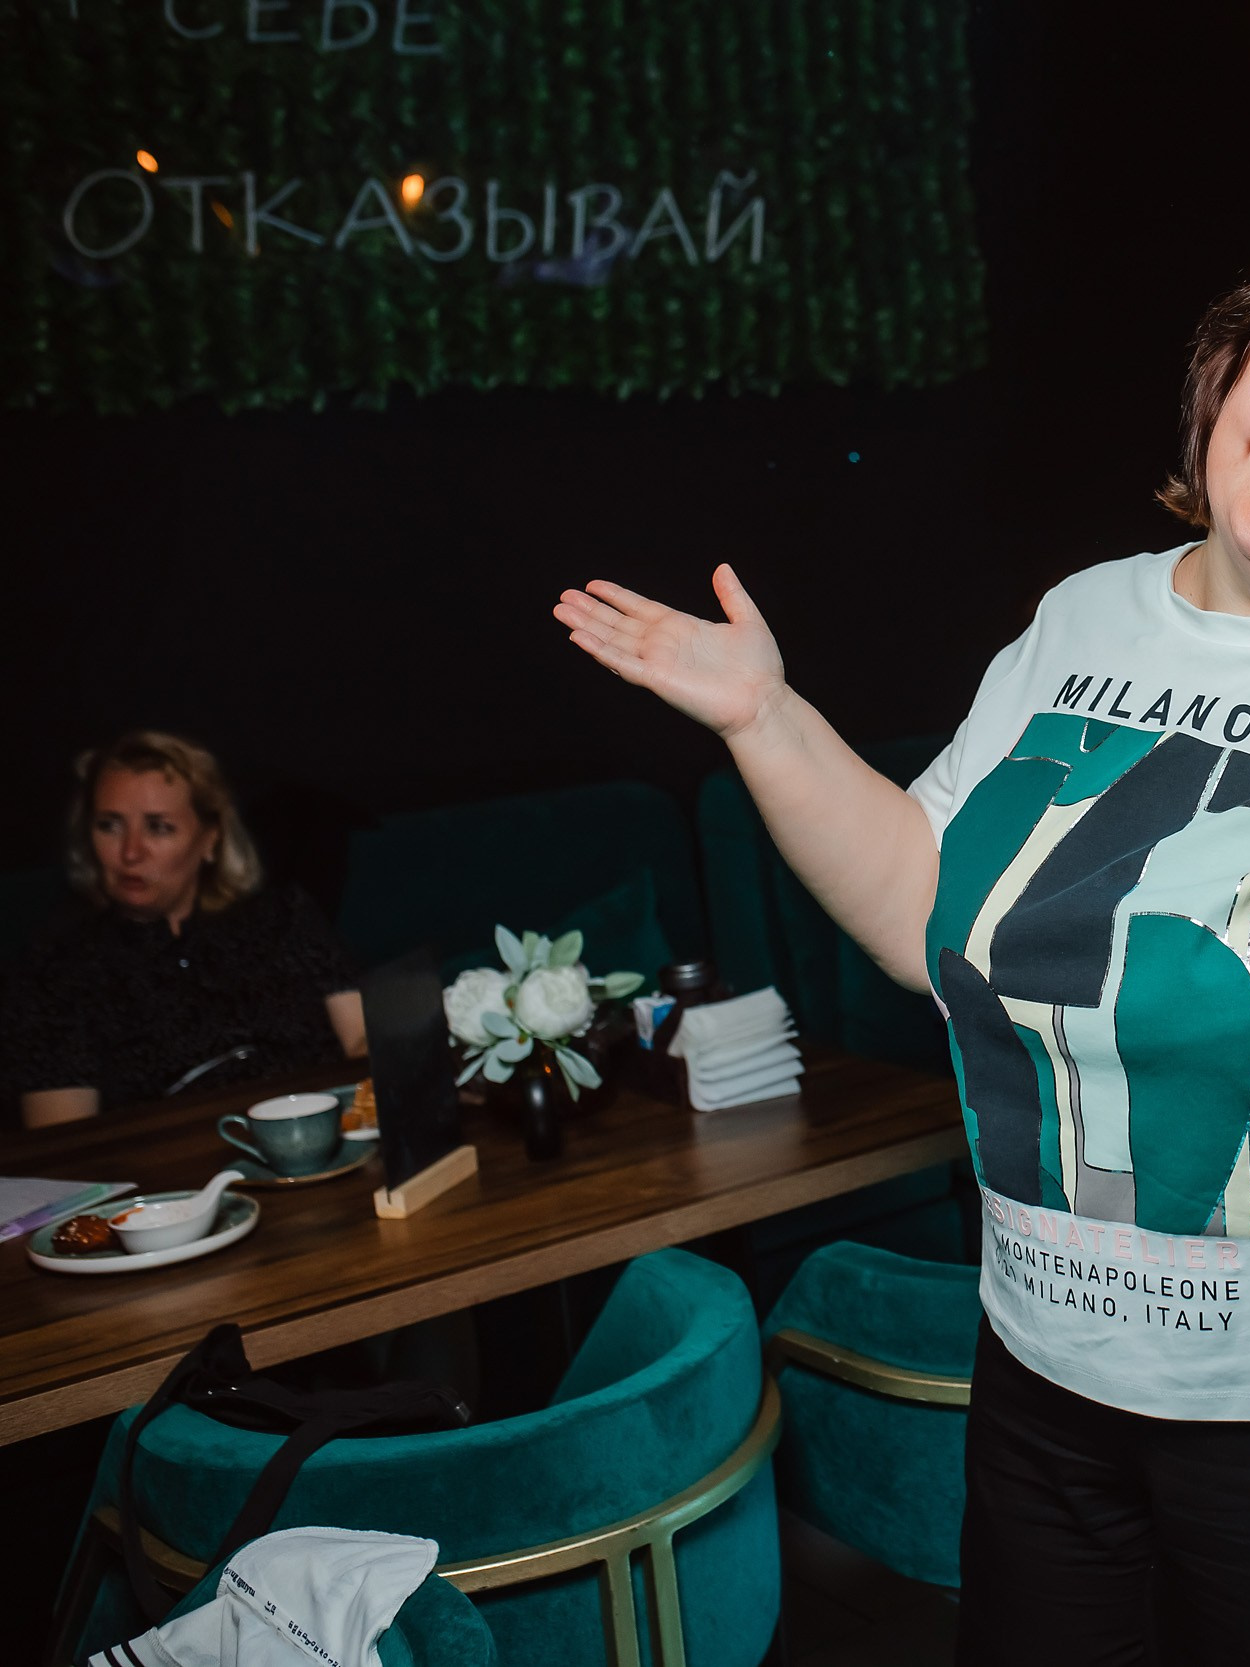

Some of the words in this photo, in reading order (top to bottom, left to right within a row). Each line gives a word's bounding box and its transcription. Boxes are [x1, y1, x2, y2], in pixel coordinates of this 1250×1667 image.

[64, 168, 765, 264] ОТКАЗЫВАЙ
[1000, 1233, 1240, 1301] MONTENAPOLEONE
[1023, 1273, 1128, 1323] MILANO,
[1146, 1304, 1233, 1332] ITALY
